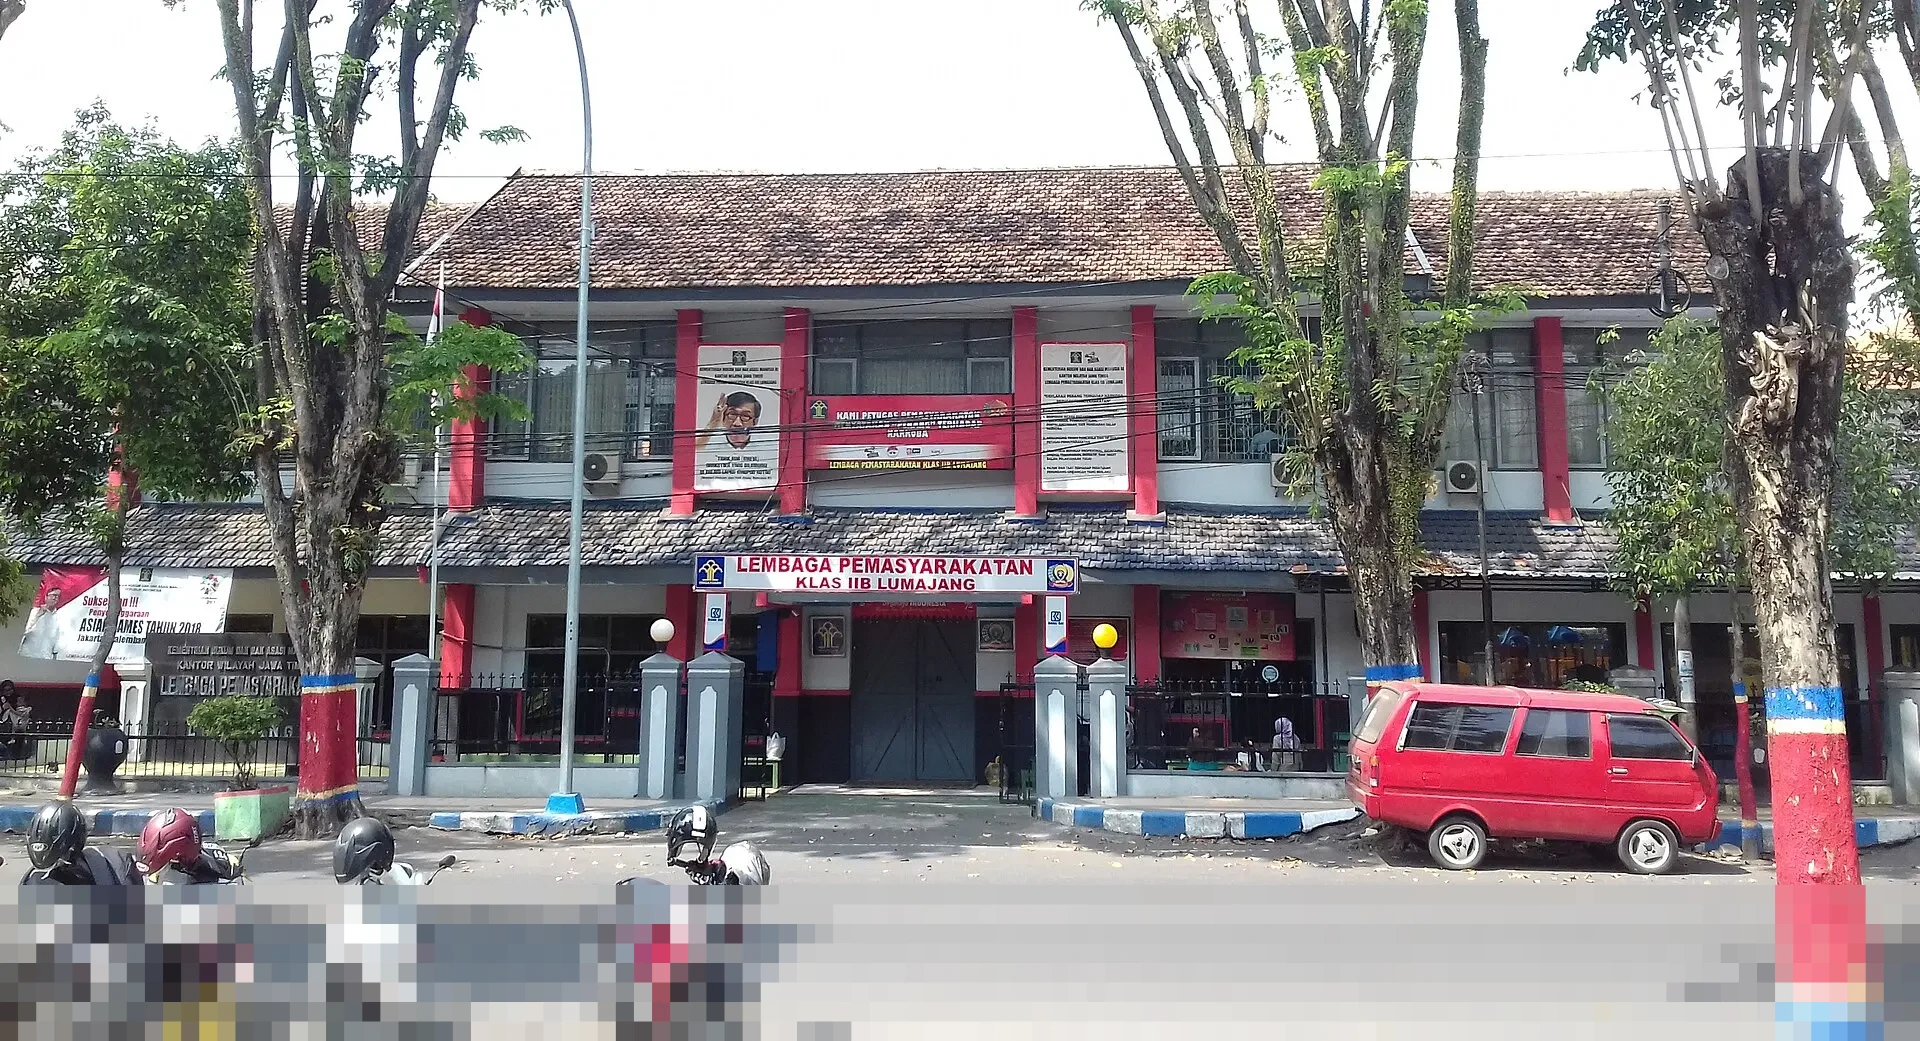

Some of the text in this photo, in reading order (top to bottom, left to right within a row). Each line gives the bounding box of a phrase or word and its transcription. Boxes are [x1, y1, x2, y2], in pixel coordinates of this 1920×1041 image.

[836, 411, 859, 420] KAMI
[861, 411, 899, 420] PETUGAS
[829, 460, 860, 469] LEMBAGA
[922, 460, 940, 469] KLAS
[736, 556, 1033, 575] LEMBAGA PEMASYARAKATAN
[796, 576, 975, 590] KLAS IIB LUMAJANG
[116, 618, 144, 634] AMES
[178, 621, 202, 634] 2018
[177, 660, 213, 670] KANTOR
[216, 660, 255, 670] WILAYAH
[258, 660, 283, 670] JAWA
[159, 675, 216, 696] LEMBAGA
